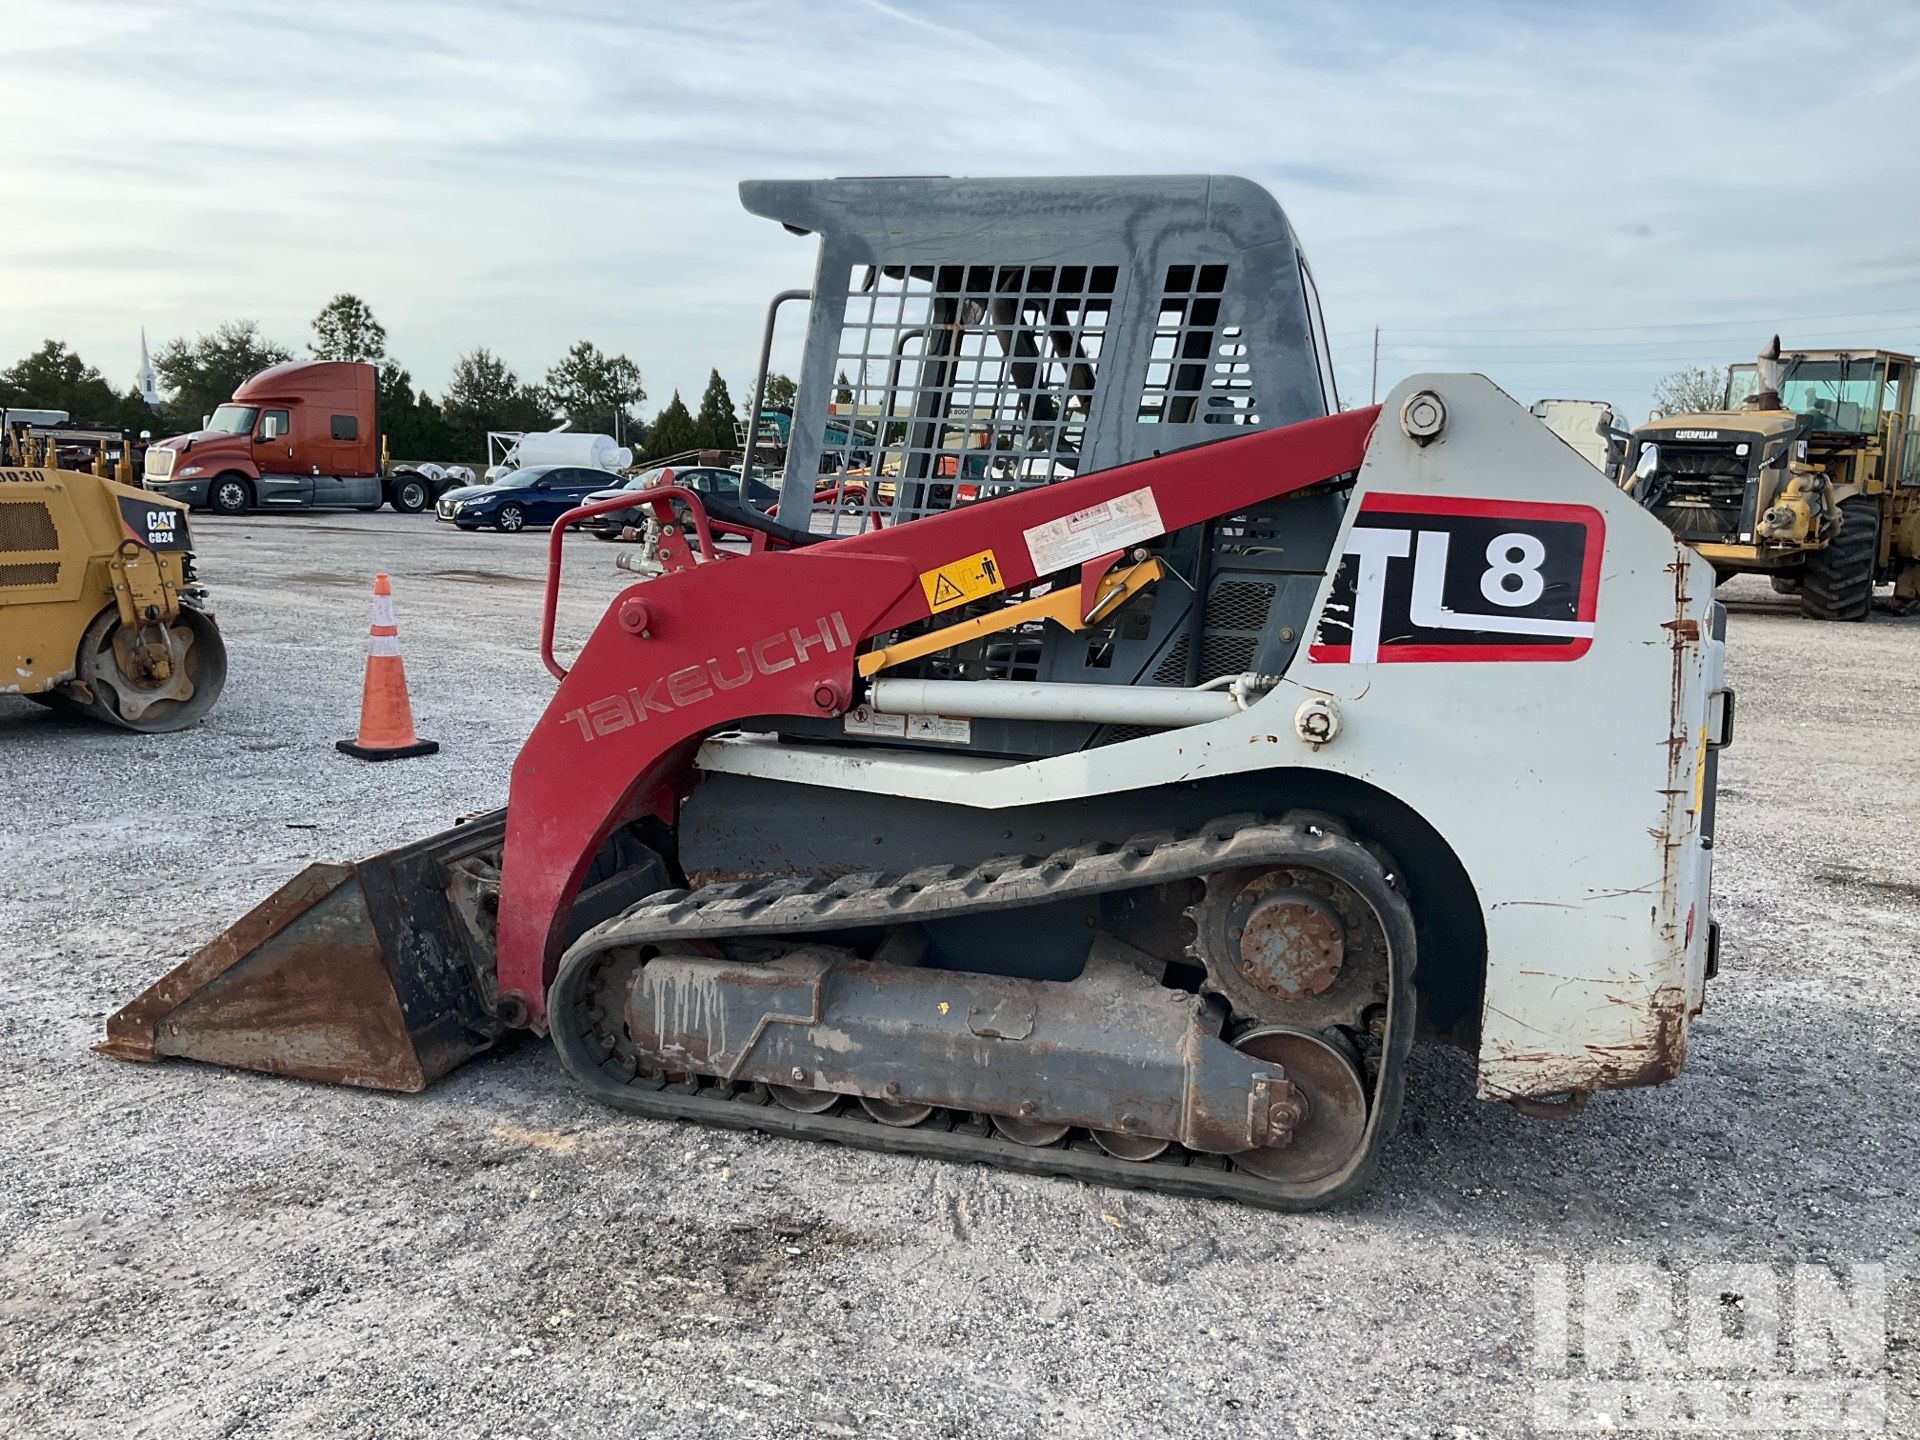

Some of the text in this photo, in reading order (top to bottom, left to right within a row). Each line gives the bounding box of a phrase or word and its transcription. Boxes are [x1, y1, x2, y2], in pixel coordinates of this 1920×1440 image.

[1675, 430, 1718, 439] CATERPILLAR
[147, 511, 177, 530] CAT
[149, 532, 174, 543] CB24
